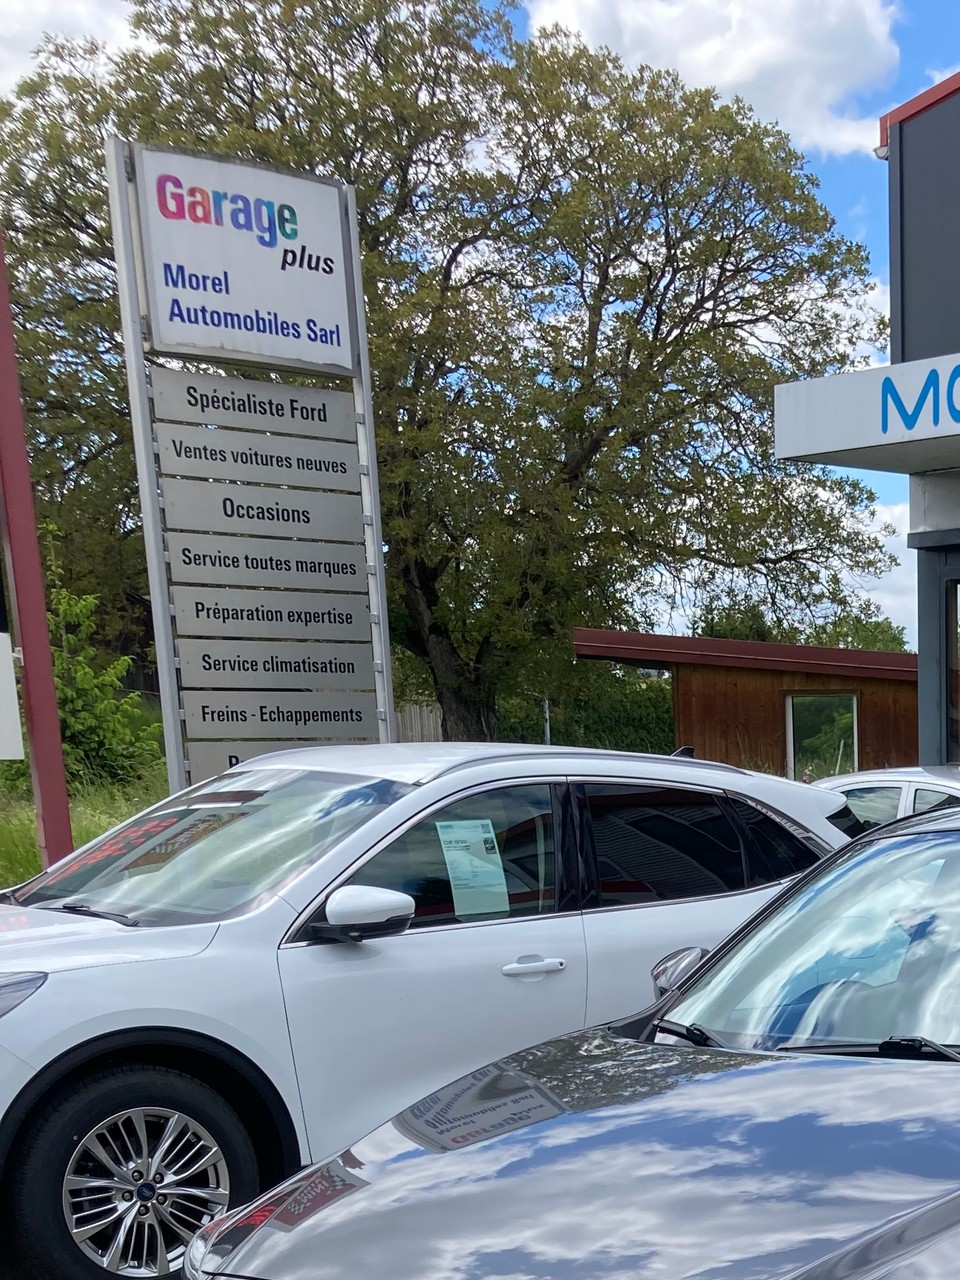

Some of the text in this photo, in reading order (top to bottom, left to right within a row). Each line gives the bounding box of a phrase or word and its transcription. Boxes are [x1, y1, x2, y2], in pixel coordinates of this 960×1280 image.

[156, 174, 298, 248] Garage
[281, 245, 335, 275] plus
[163, 262, 230, 295] Morel
[169, 298, 341, 348] Automobiles Sarl
[186, 385, 328, 423] Spécialiste Ford
[172, 439, 347, 474] Ventes voitures neuves
[222, 497, 311, 524] Occasions
[181, 547, 357, 578] Service toutes marques
[195, 601, 353, 627] Préparation expertise
[202, 653, 355, 674] Service climatisation
[201, 705, 248, 722] Freins
[259, 705, 363, 726] Echappements
